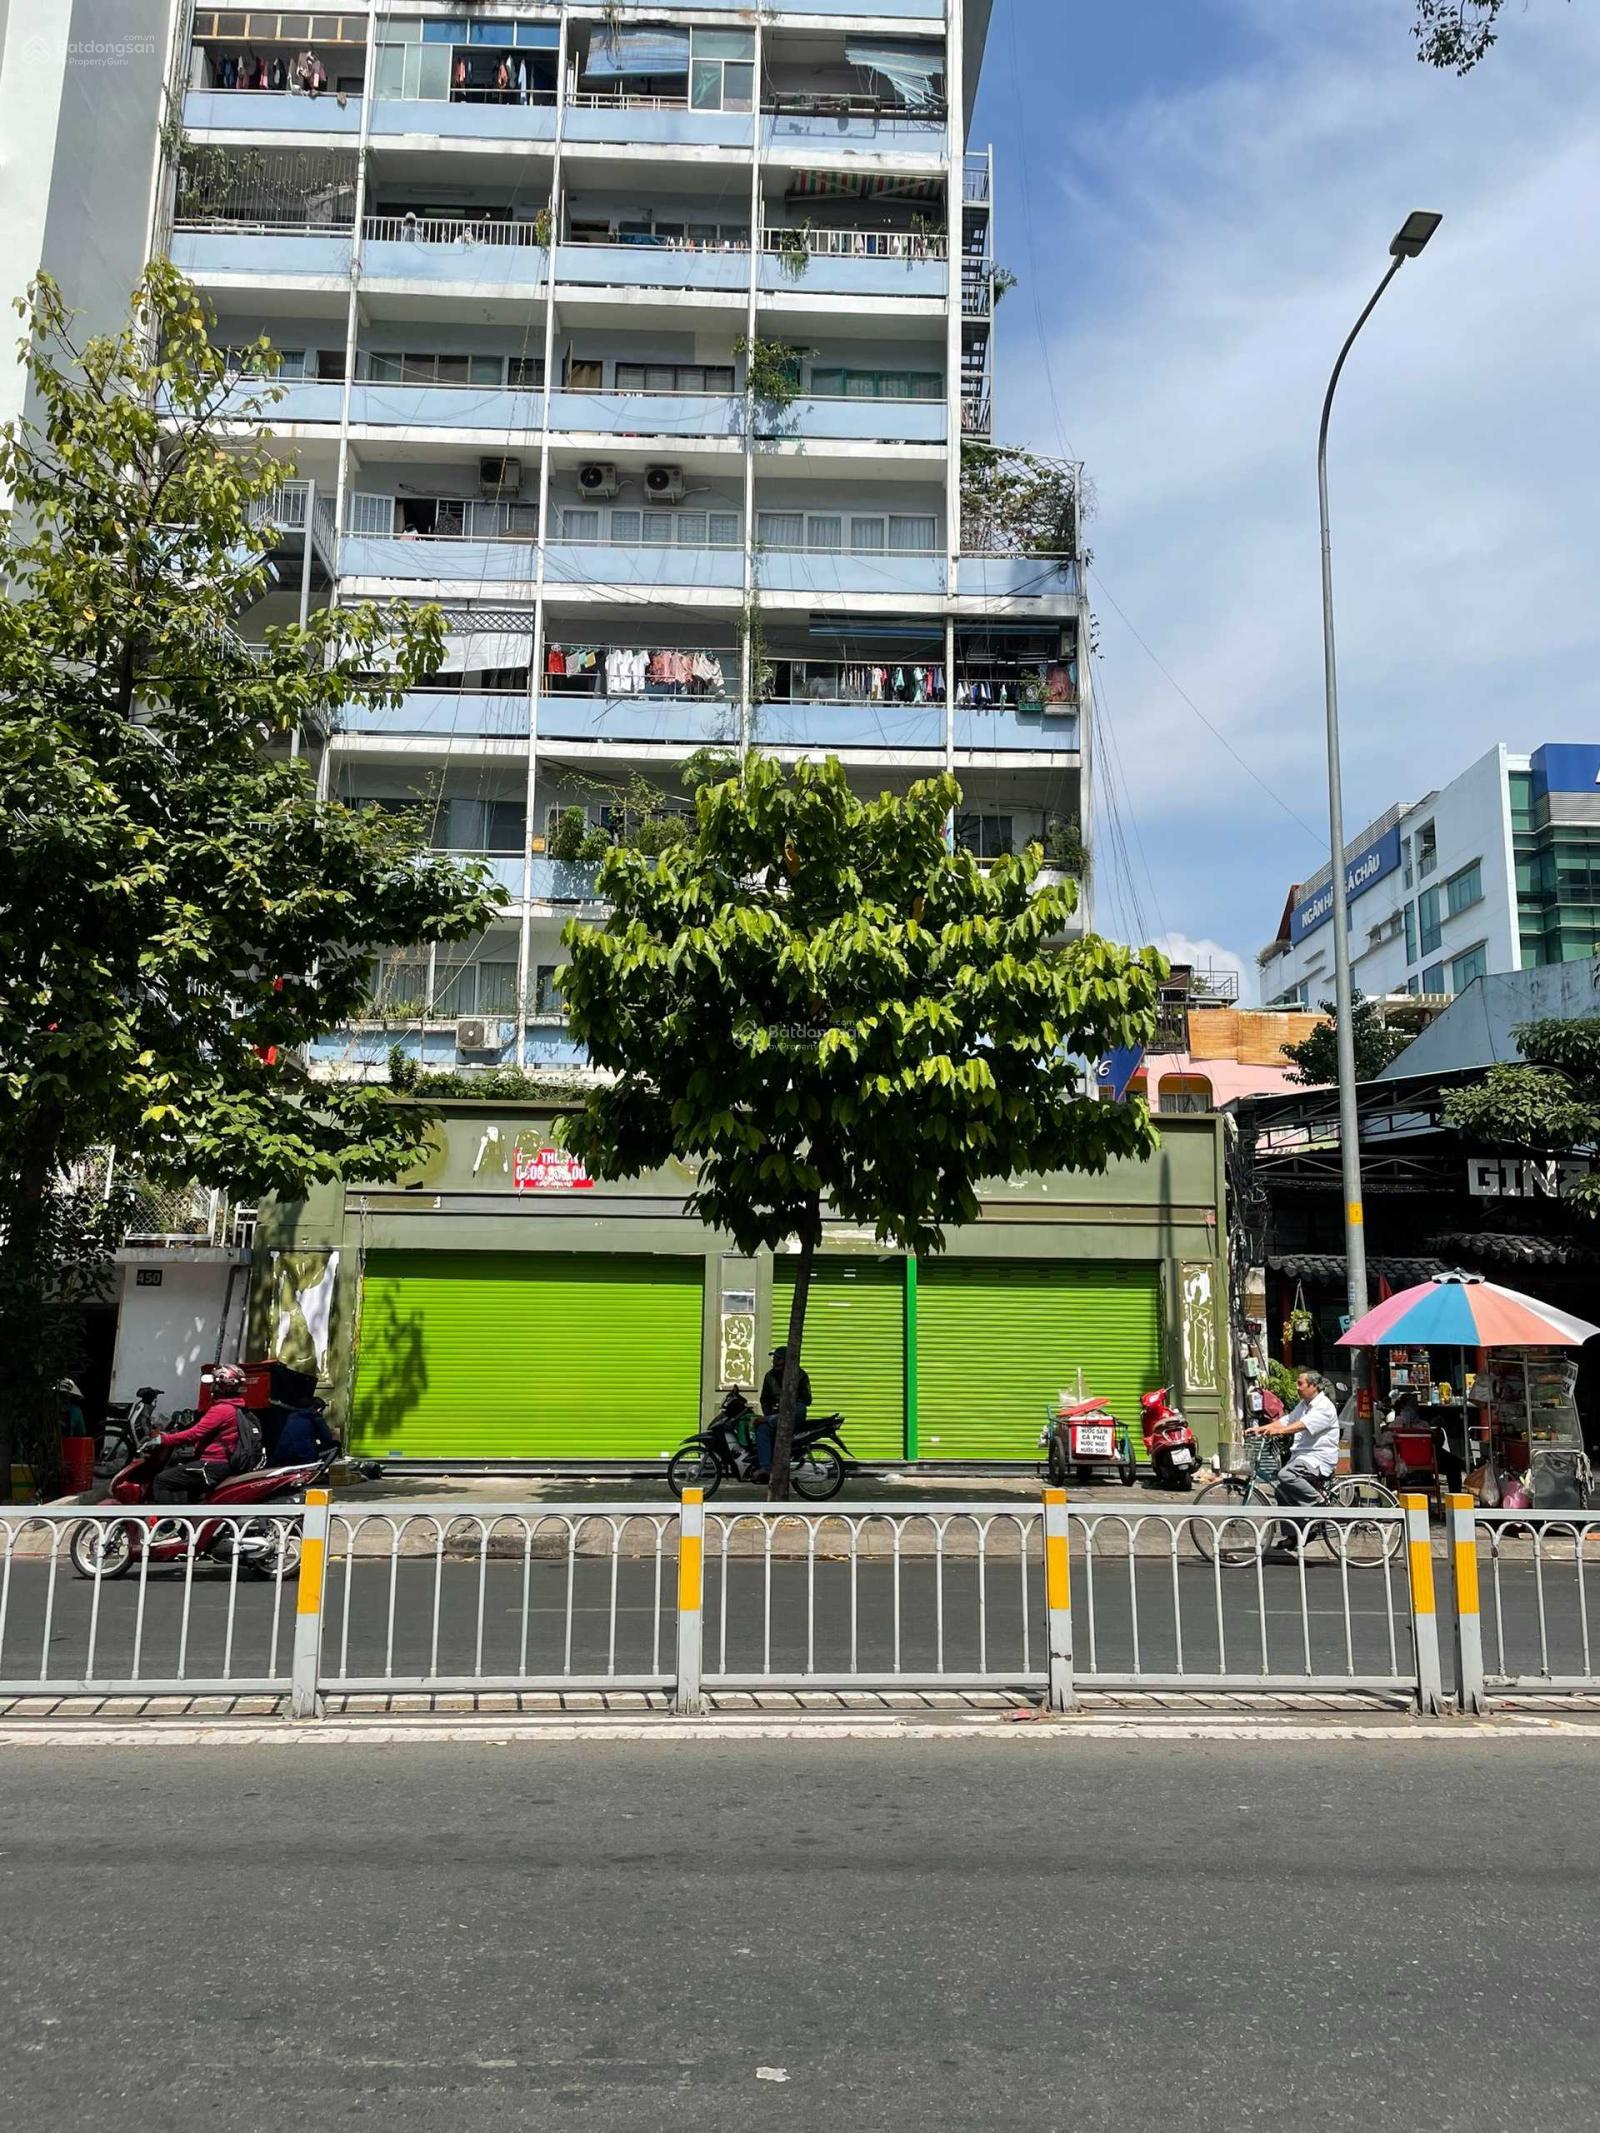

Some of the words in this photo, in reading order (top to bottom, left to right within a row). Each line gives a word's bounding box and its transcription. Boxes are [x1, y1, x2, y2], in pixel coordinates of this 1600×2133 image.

[1302, 899, 1324, 928] NGÂN
[1355, 853, 1380, 885] CHÂU
[137, 1272, 161, 1284] 450
